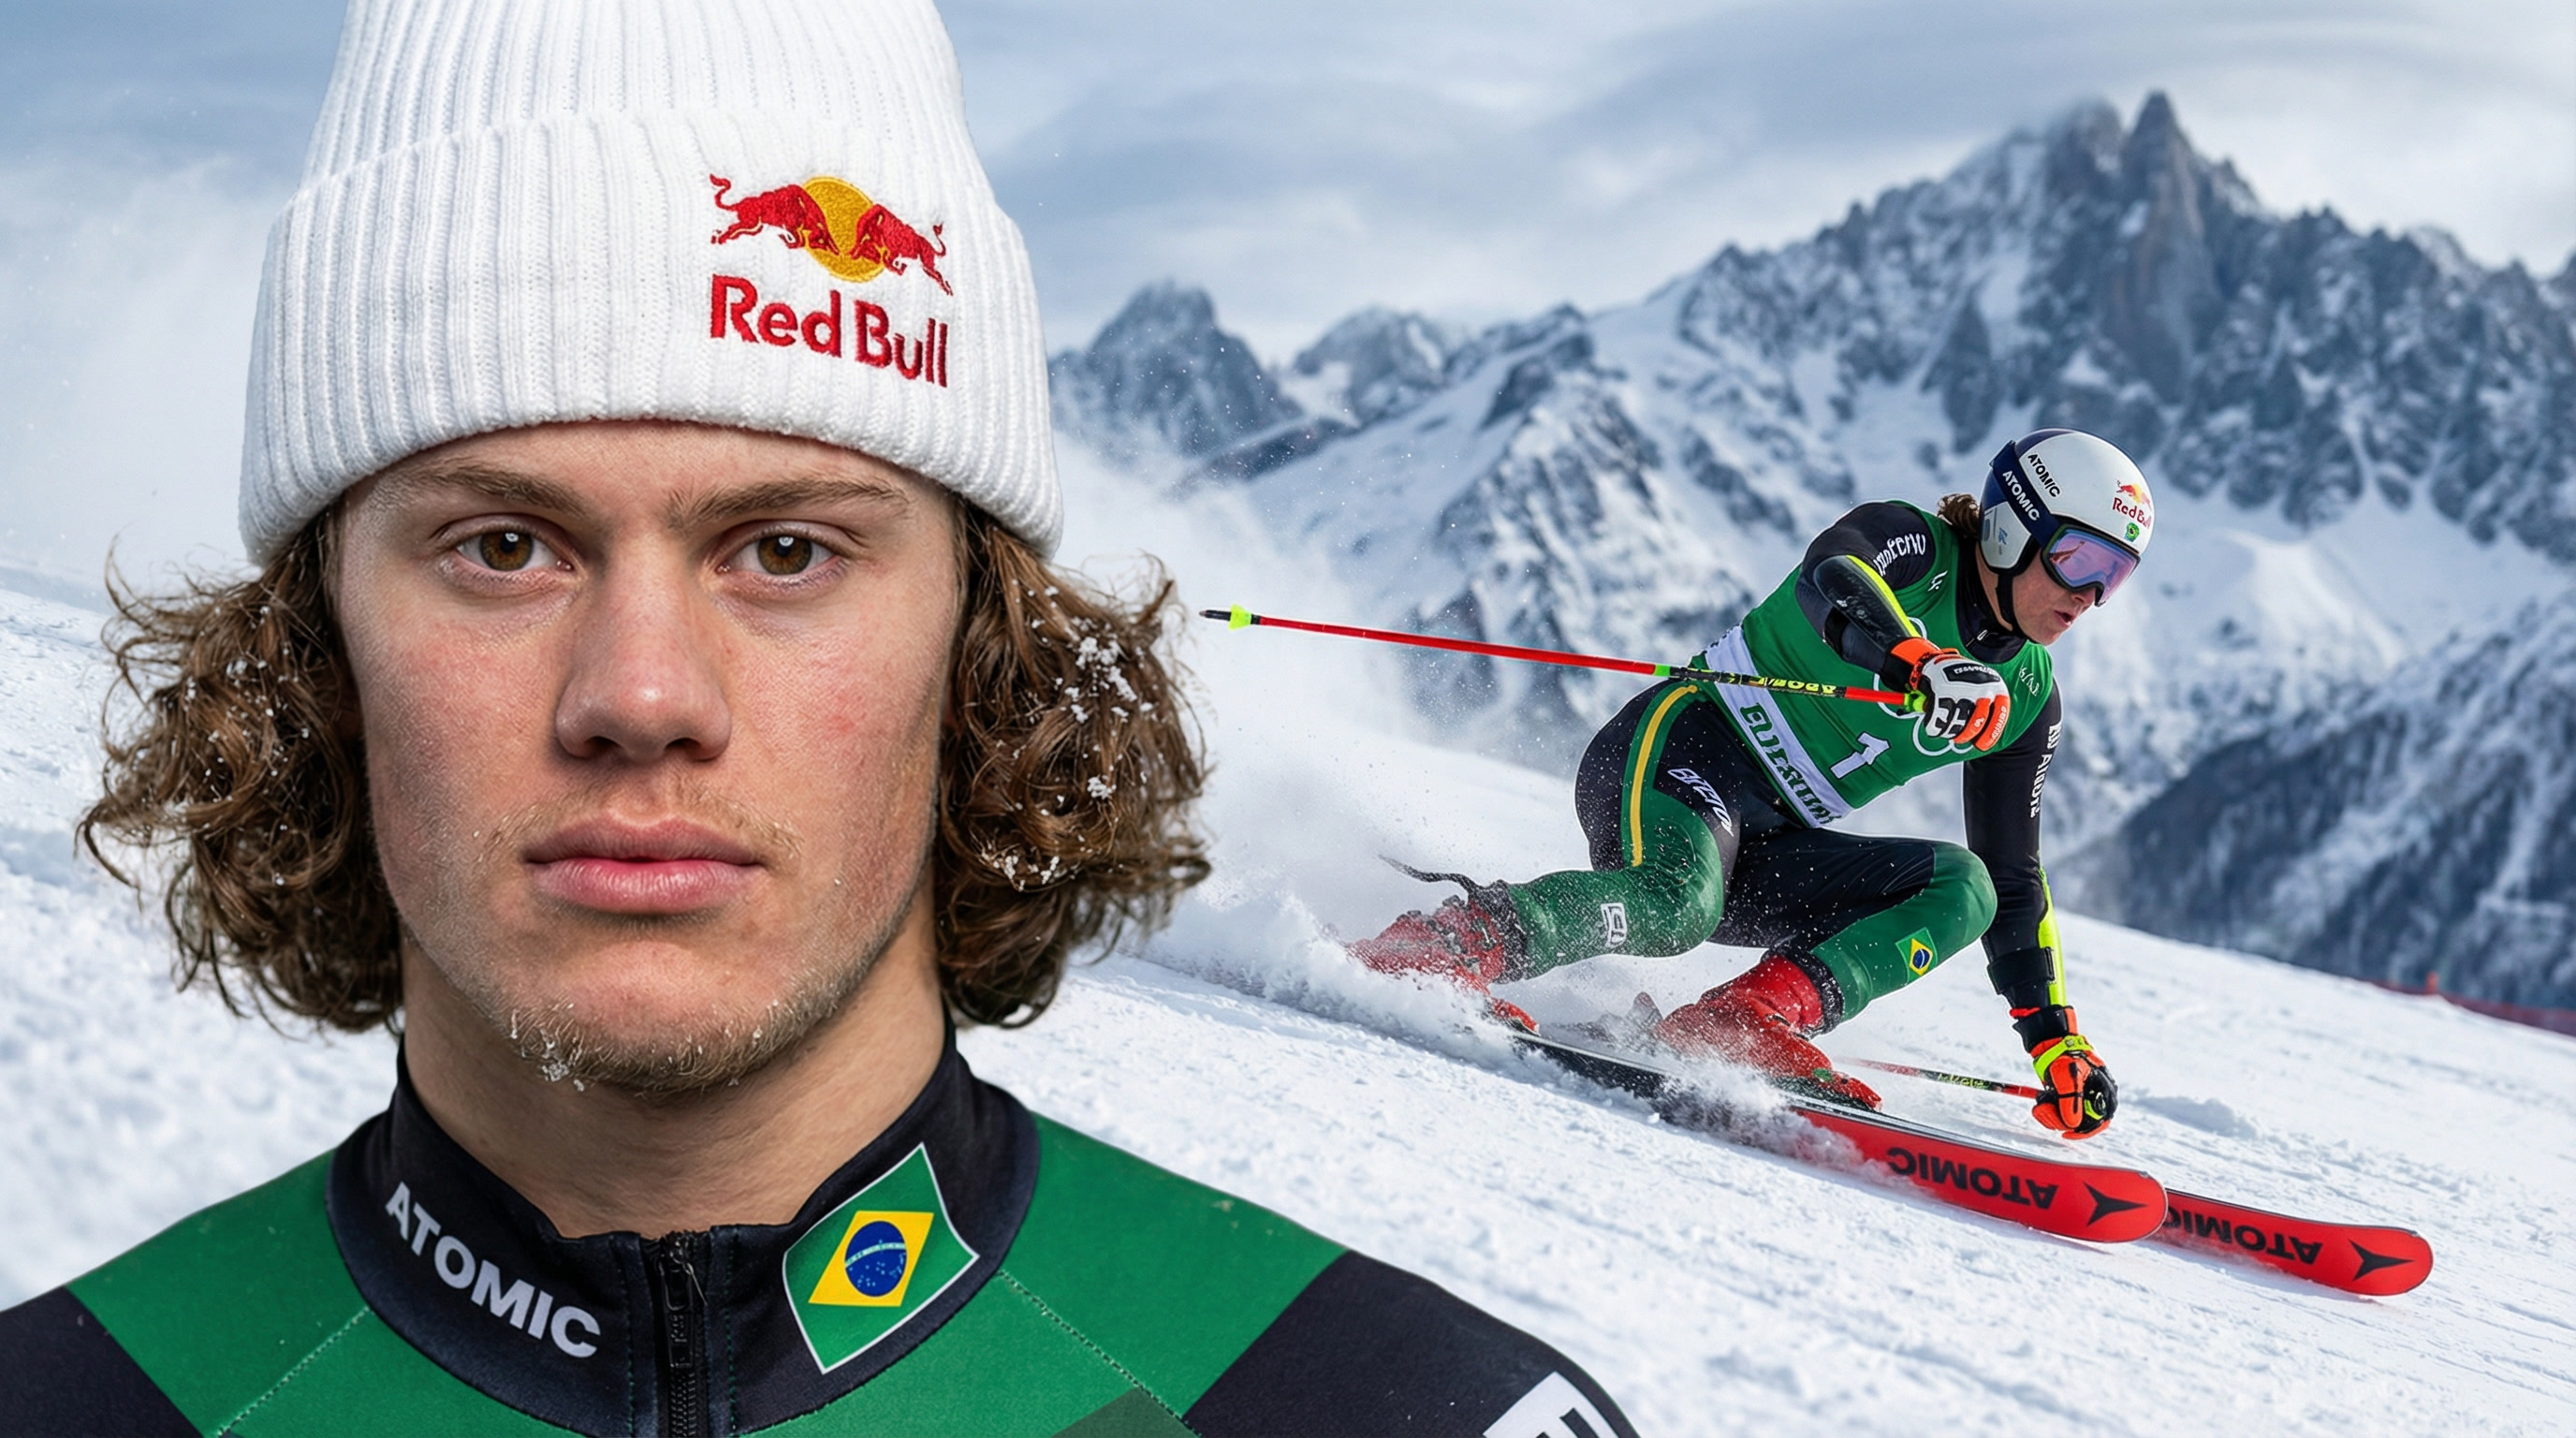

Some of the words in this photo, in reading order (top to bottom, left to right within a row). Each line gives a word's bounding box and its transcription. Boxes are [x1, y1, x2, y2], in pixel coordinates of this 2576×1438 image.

[710, 273, 842, 359] Red
[854, 299, 948, 388] Bull
[2002, 470, 2041, 521] ATOMIC
[2027, 454, 2060, 498] ATOMIC
[1829, 731, 1891, 780] 1
[1886, 1147, 2058, 1211] ATOMIC
[385, 1181, 601, 1358] ATOMIC
